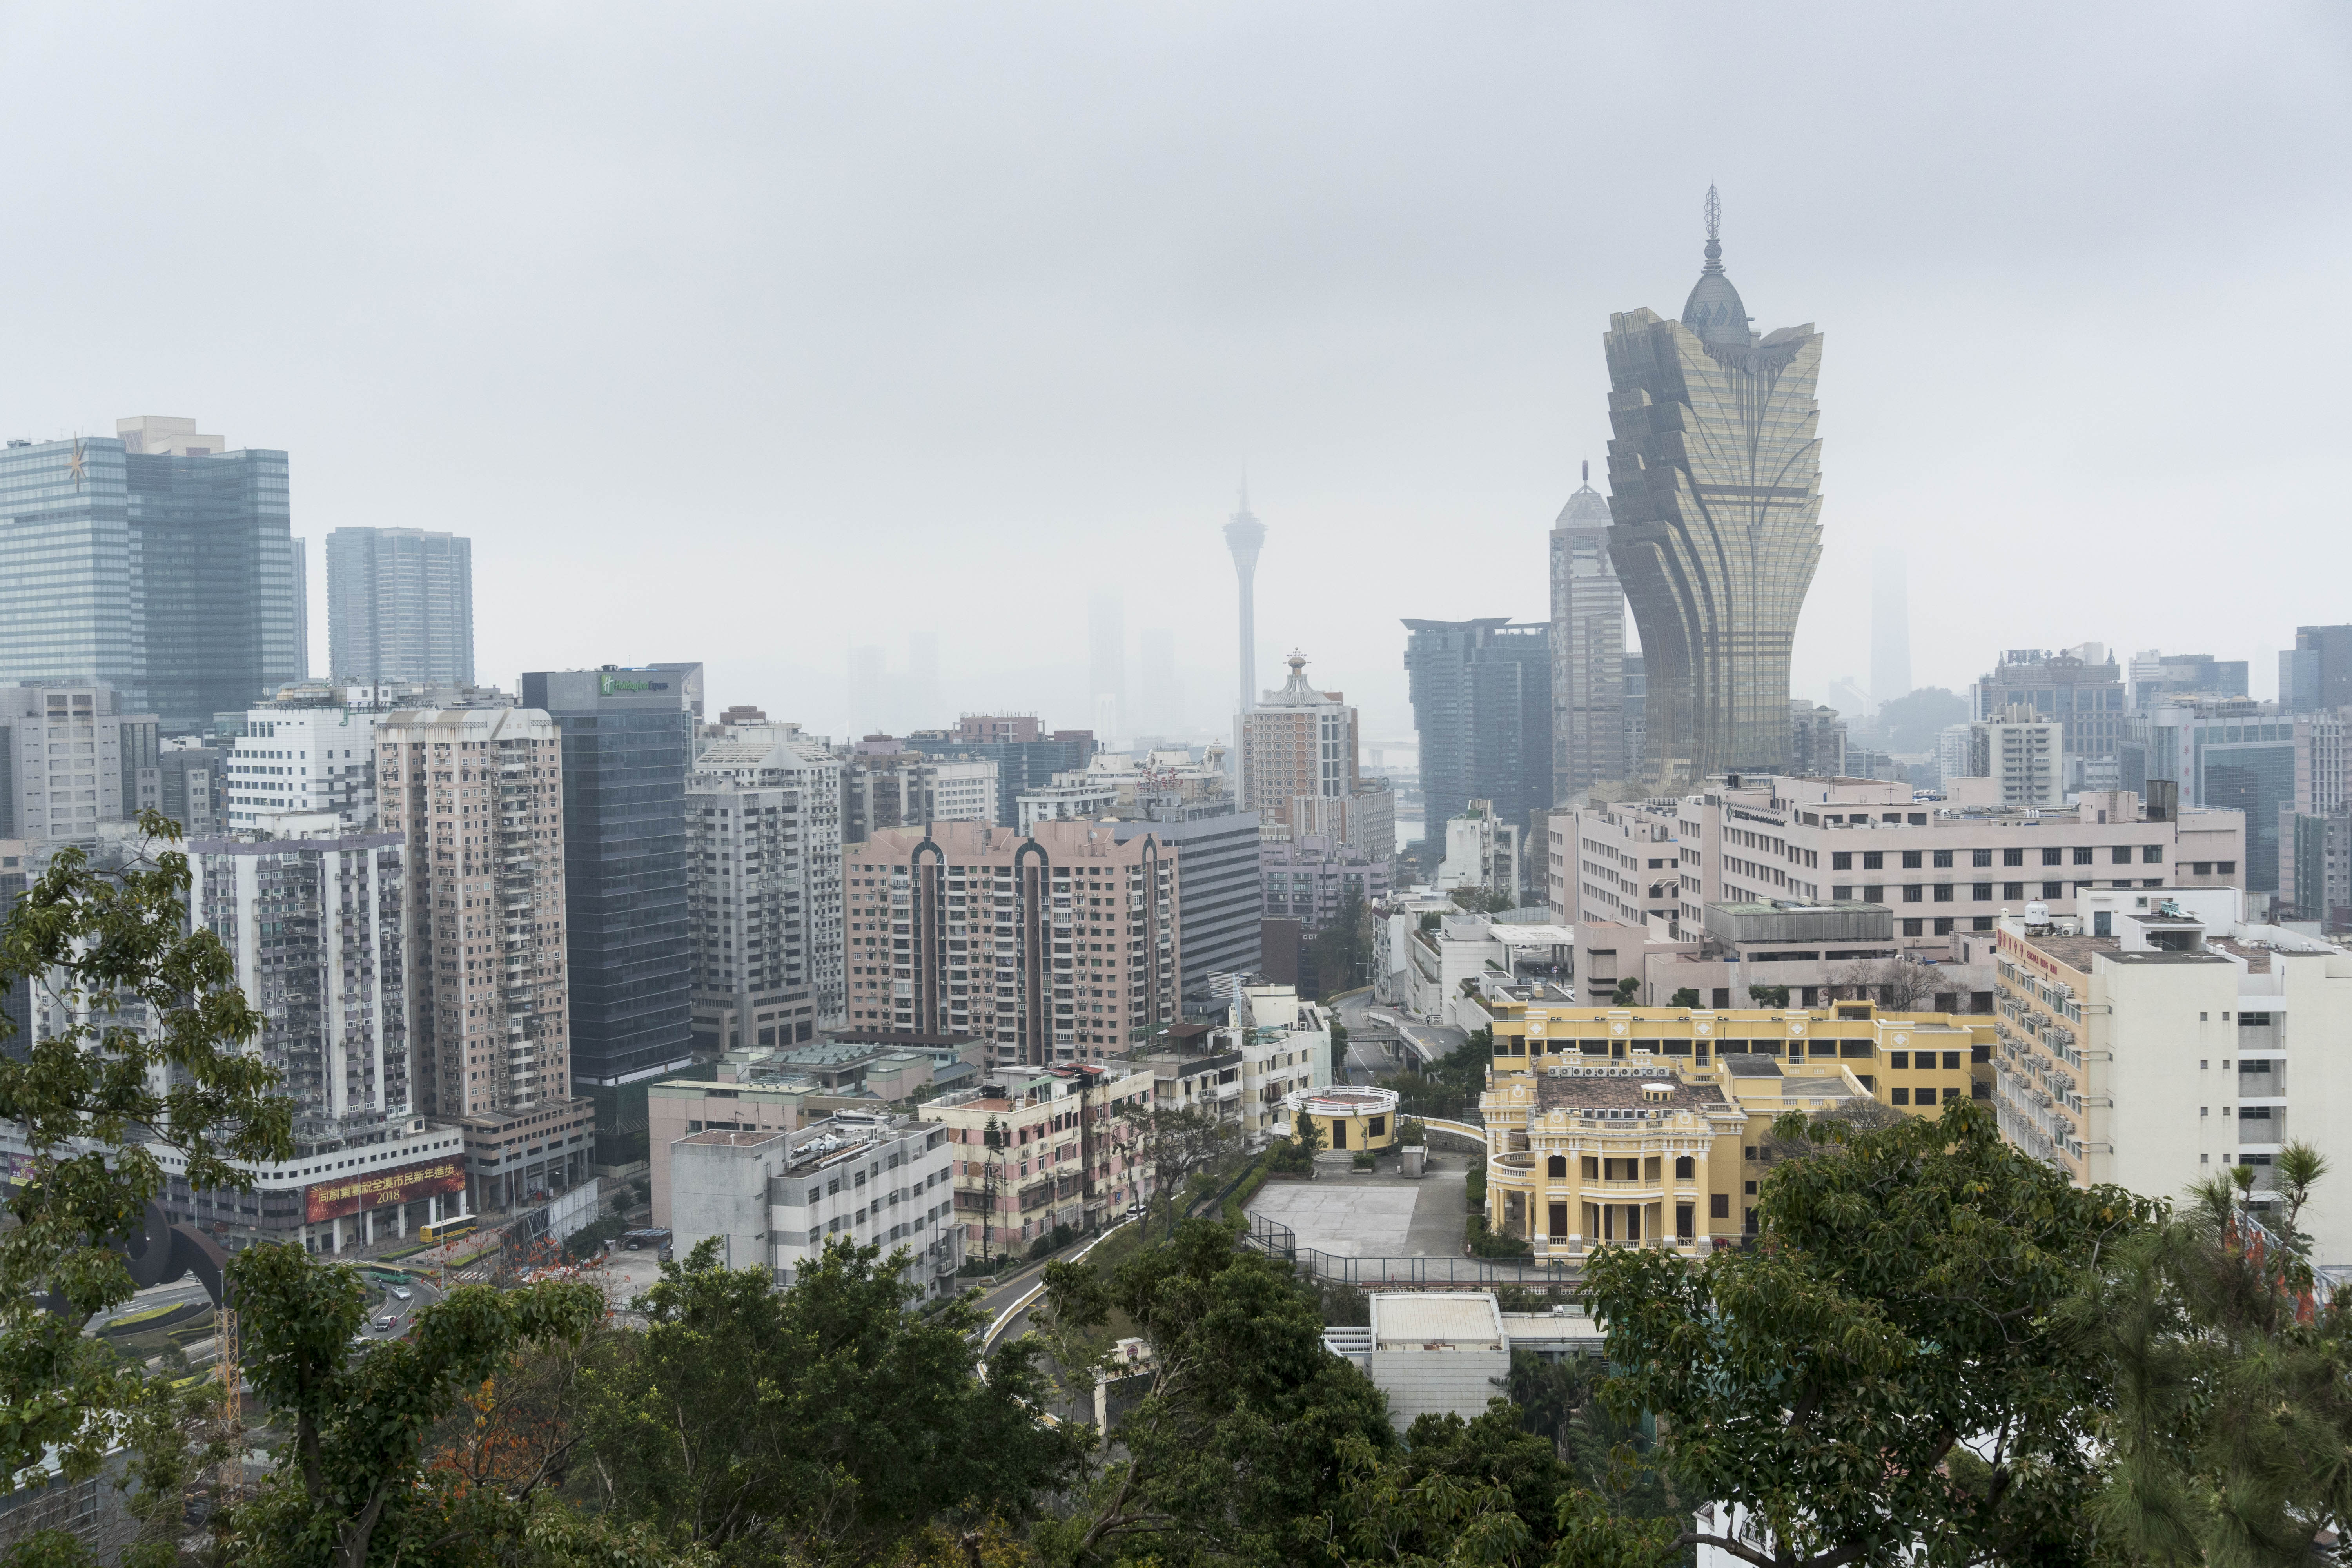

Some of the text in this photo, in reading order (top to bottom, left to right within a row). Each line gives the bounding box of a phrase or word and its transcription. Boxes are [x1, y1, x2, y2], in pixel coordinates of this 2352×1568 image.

[615, 680, 639, 692] Holiday
[639, 680, 649, 690] Inn
[319, 1164, 454, 1204] 同創集團祝全澳市民新年進步
[377, 1189, 400, 1204] 2018
